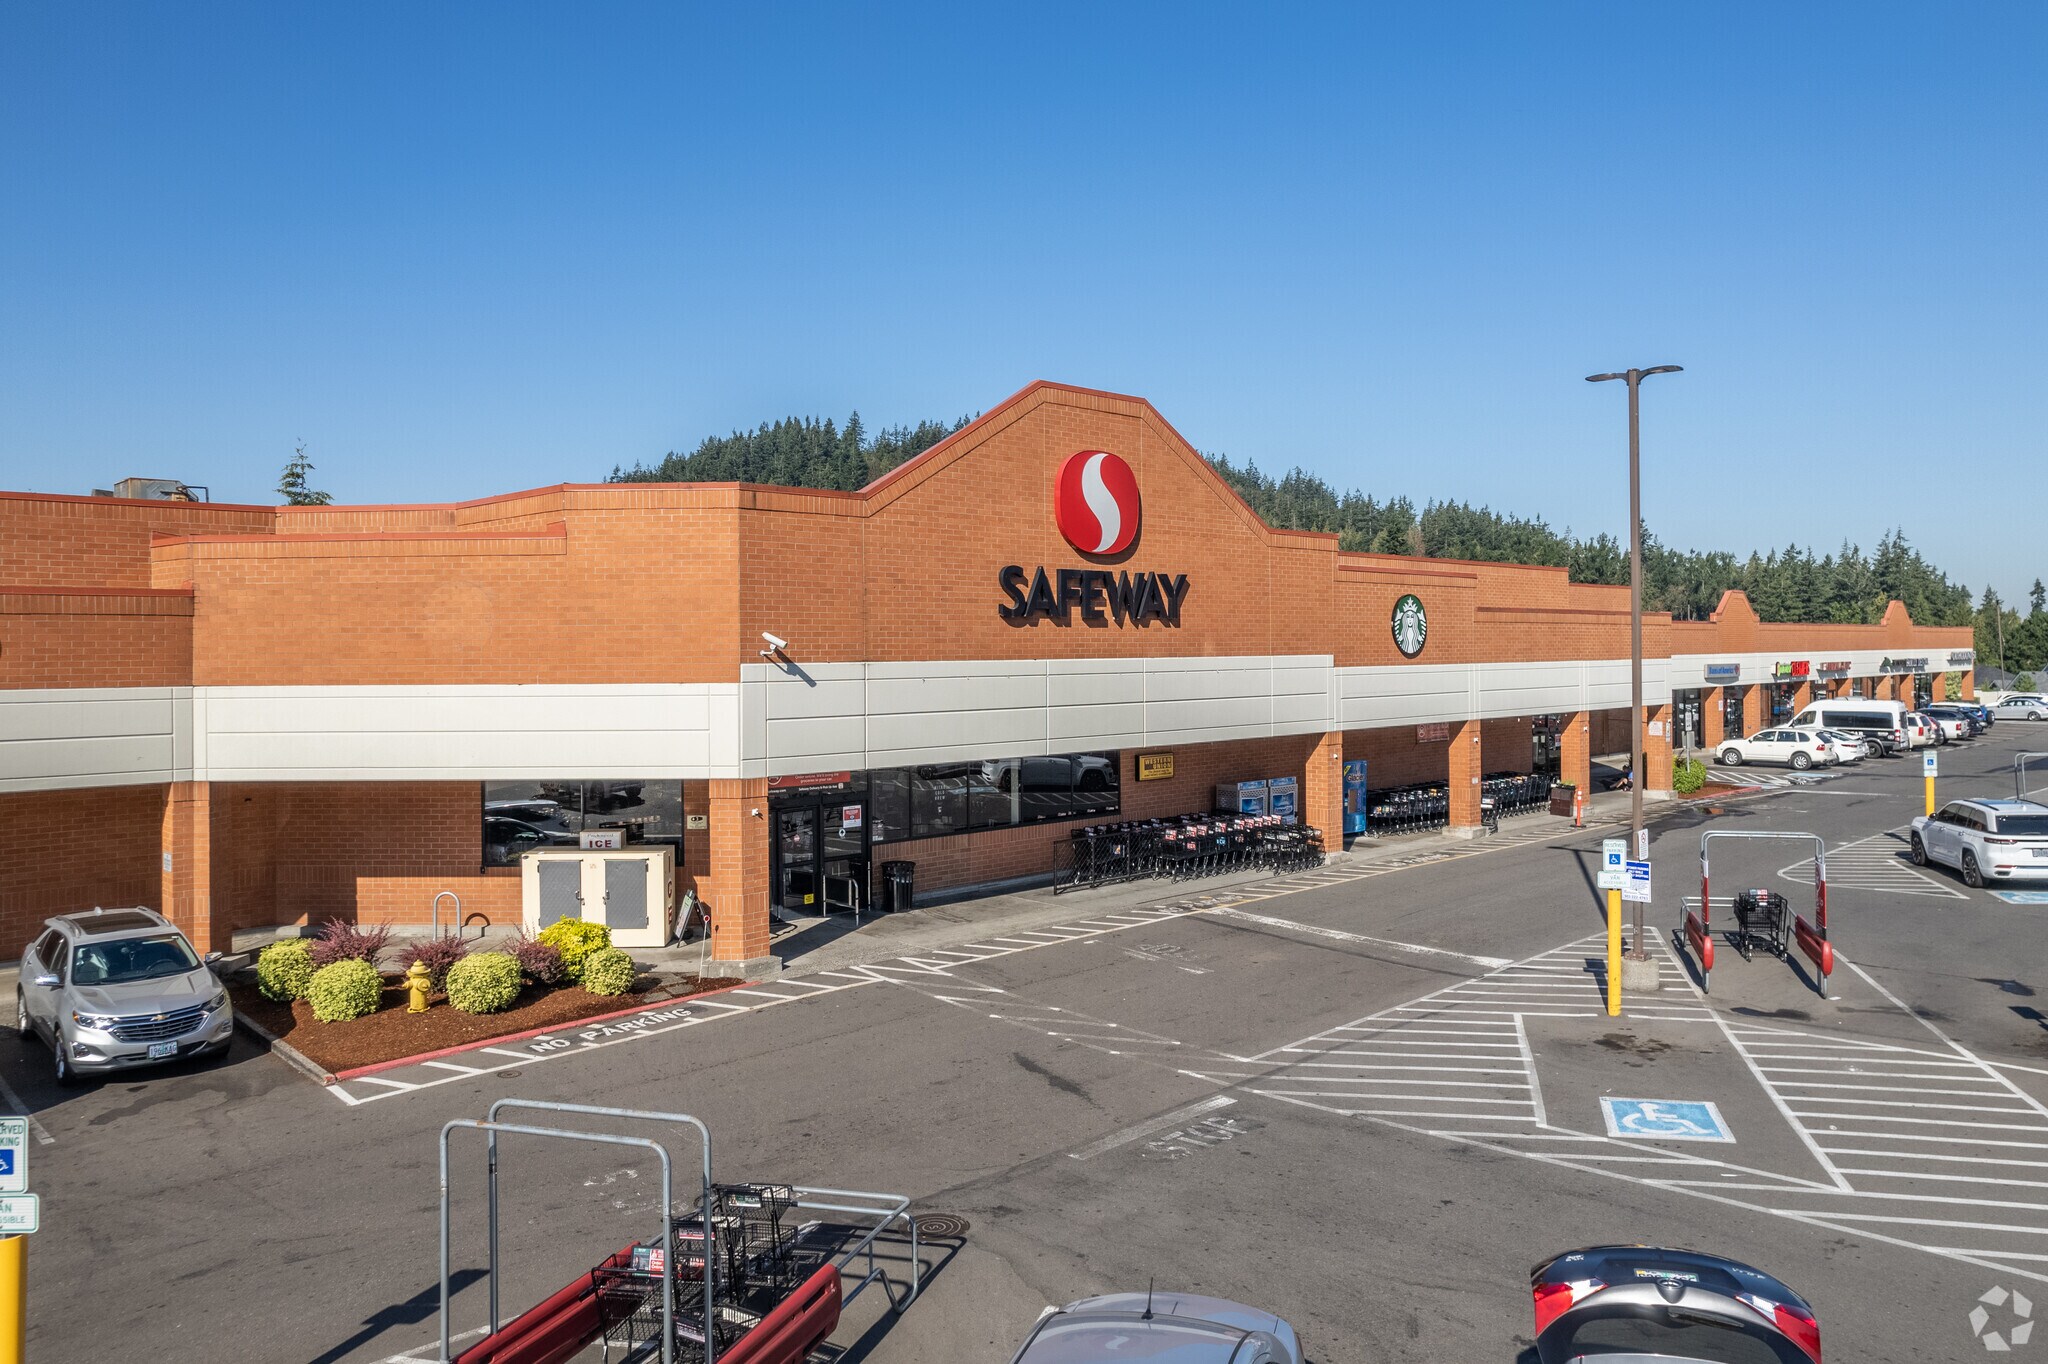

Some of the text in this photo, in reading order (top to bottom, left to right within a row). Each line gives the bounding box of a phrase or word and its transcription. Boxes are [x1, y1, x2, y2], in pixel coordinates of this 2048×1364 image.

[998, 565, 1188, 620] SAFEWAY
[530, 1008, 692, 1052] NO PARKING
[1142, 1117, 1248, 1159] STOP
